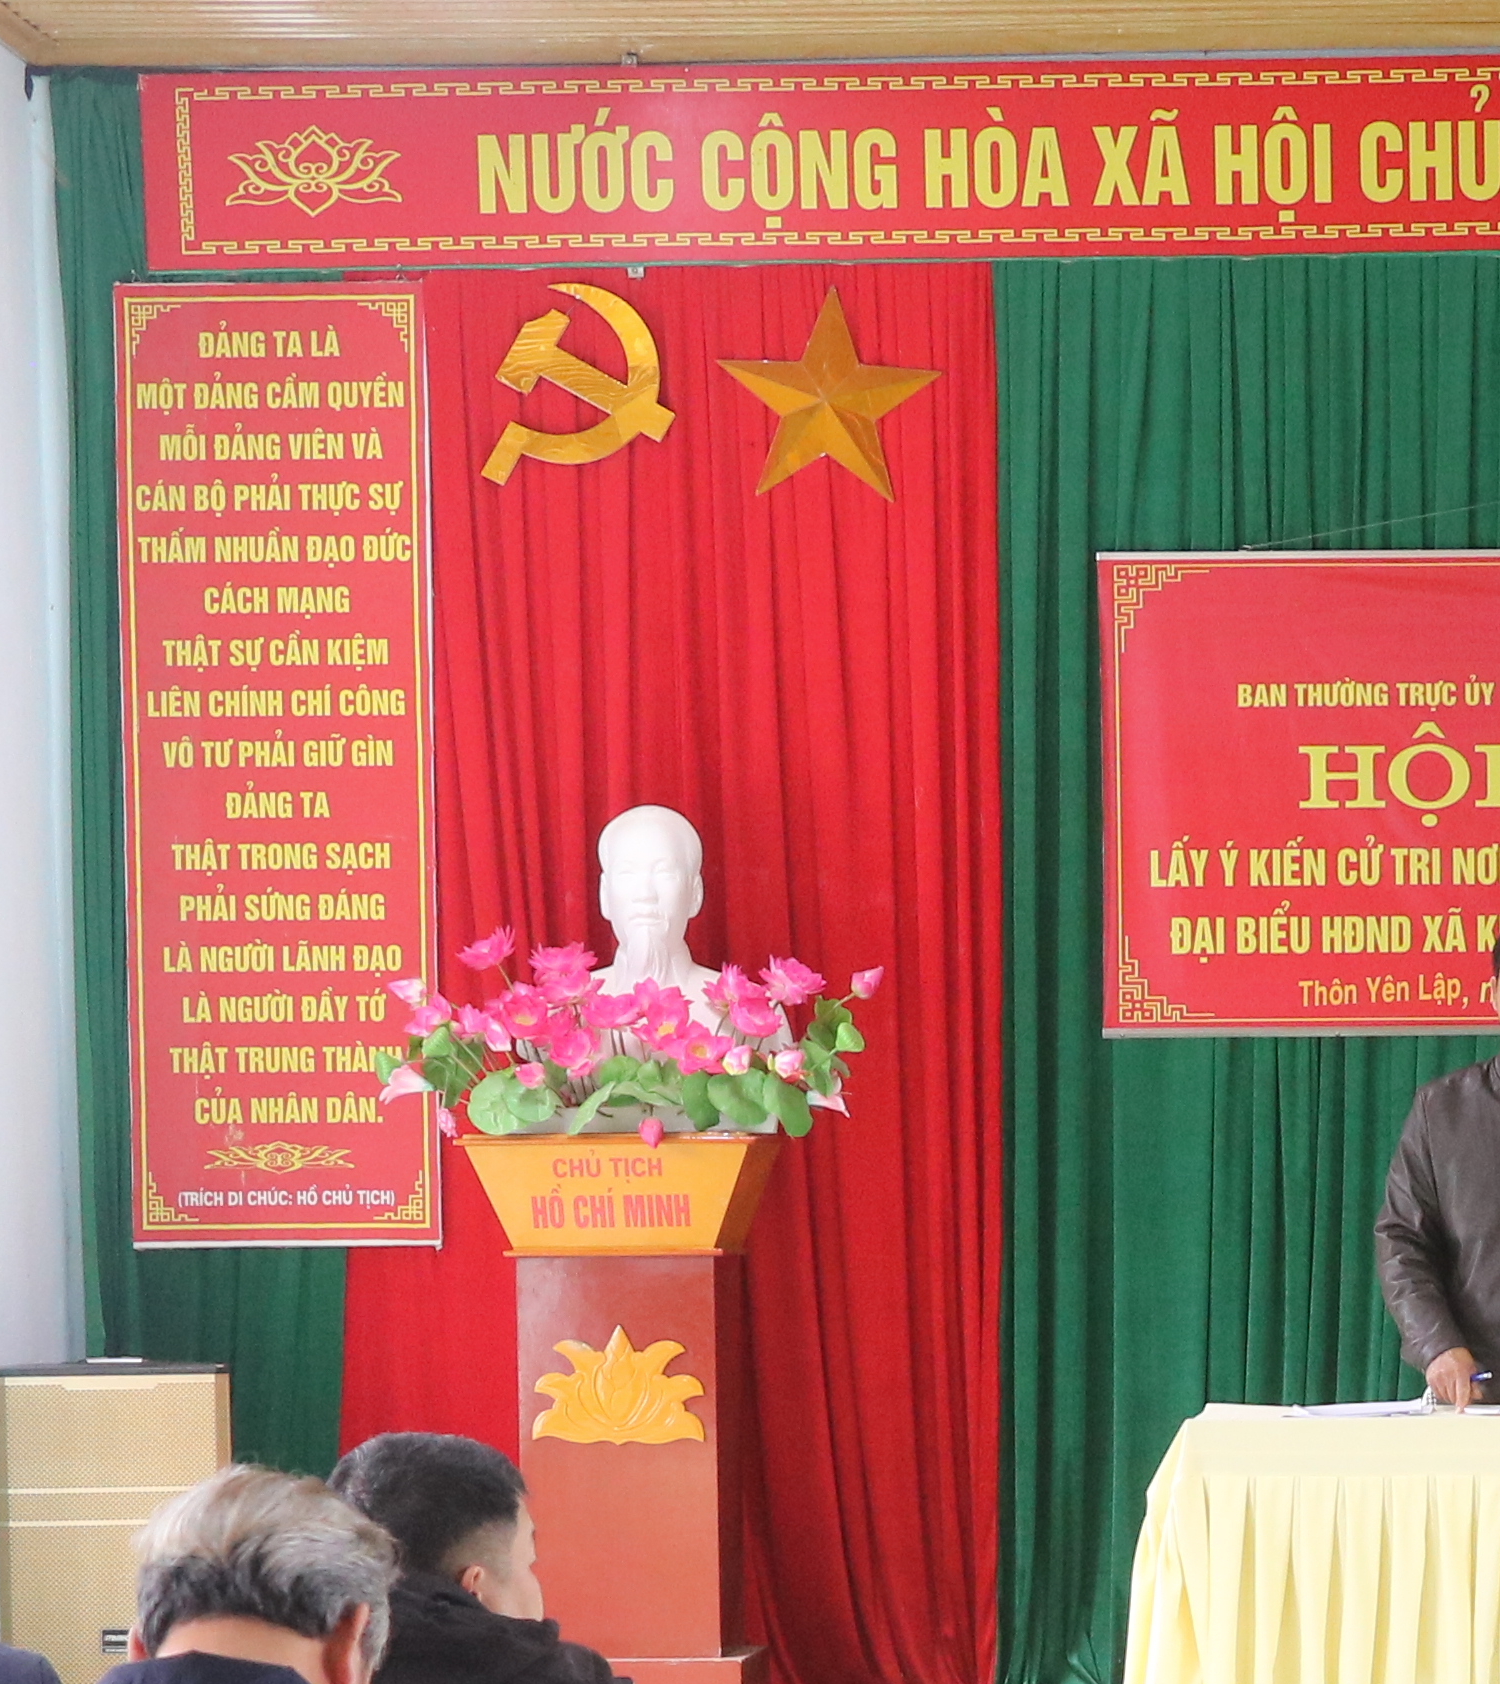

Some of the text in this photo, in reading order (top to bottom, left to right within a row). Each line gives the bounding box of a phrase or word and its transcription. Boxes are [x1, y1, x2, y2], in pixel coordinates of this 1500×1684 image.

[477, 107, 674, 214] NƯỚC
[701, 112, 897, 229] CỘNG
[924, 107, 1069, 208] HÒA
[1092, 109, 1190, 206] XÃ
[1214, 106, 1332, 222] HỘI
[198, 321, 340, 358] ĐẢNG TA LÀ
[137, 372, 404, 415] MỘT ĐẢNG CẦM QUYỀN
[160, 423, 383, 461] MỖI ĐẢNG VIÊN VÀ
[136, 473, 404, 517] CÁN BỘ PHẢI THỰC SỰ
[137, 527, 411, 568] THẤM NHUẦN ĐẠO ĐỨC
[204, 582, 350, 619] CÁCH MẠNG
[162, 630, 388, 672] THẬT SỰ CẦN KIỆM
[1238, 684, 1286, 707] BAN
[1294, 677, 1388, 707] THƯỜNG
[1396, 680, 1456, 711] TRỰC
[1465, 675, 1494, 706] ỦY
[226, 781, 330, 818] ĐẢNG TA
[171, 838, 390, 876] THẬT TRONG SẠCH
[1150, 836, 1208, 887] LẤY
[1219, 841, 1238, 886] Ý
[1250, 836, 1326, 886] KIẾN
[1337, 835, 1384, 886] CỬ
[1390, 848, 1441, 885] TRI
[180, 884, 385, 921] PHẢI SỨNG ĐÁNG
[1170, 917, 1224, 963] ĐẠI
[1237, 900, 1310, 954] BIỂU
[1322, 916, 1411, 953] HĐND
[1423, 908, 1466, 952] XÃ
[164, 939, 401, 977] LÀ NGƯỜI LÃNH ĐẠO
[1298, 978, 1357, 1007] Thôn
[1366, 975, 1409, 1003] Yên
[1419, 972, 1468, 1009] Lập,
[195, 1087, 383, 1124] CỦA NHÂN DÂN.
[552, 1149, 663, 1183] CHỦ TỊCH
[178, 1184, 395, 1209] (TRÍCH DI CHÚC: HỒ CHỦ TỊCH)
[531, 1184, 691, 1229] HỒ CHÍ MINH
